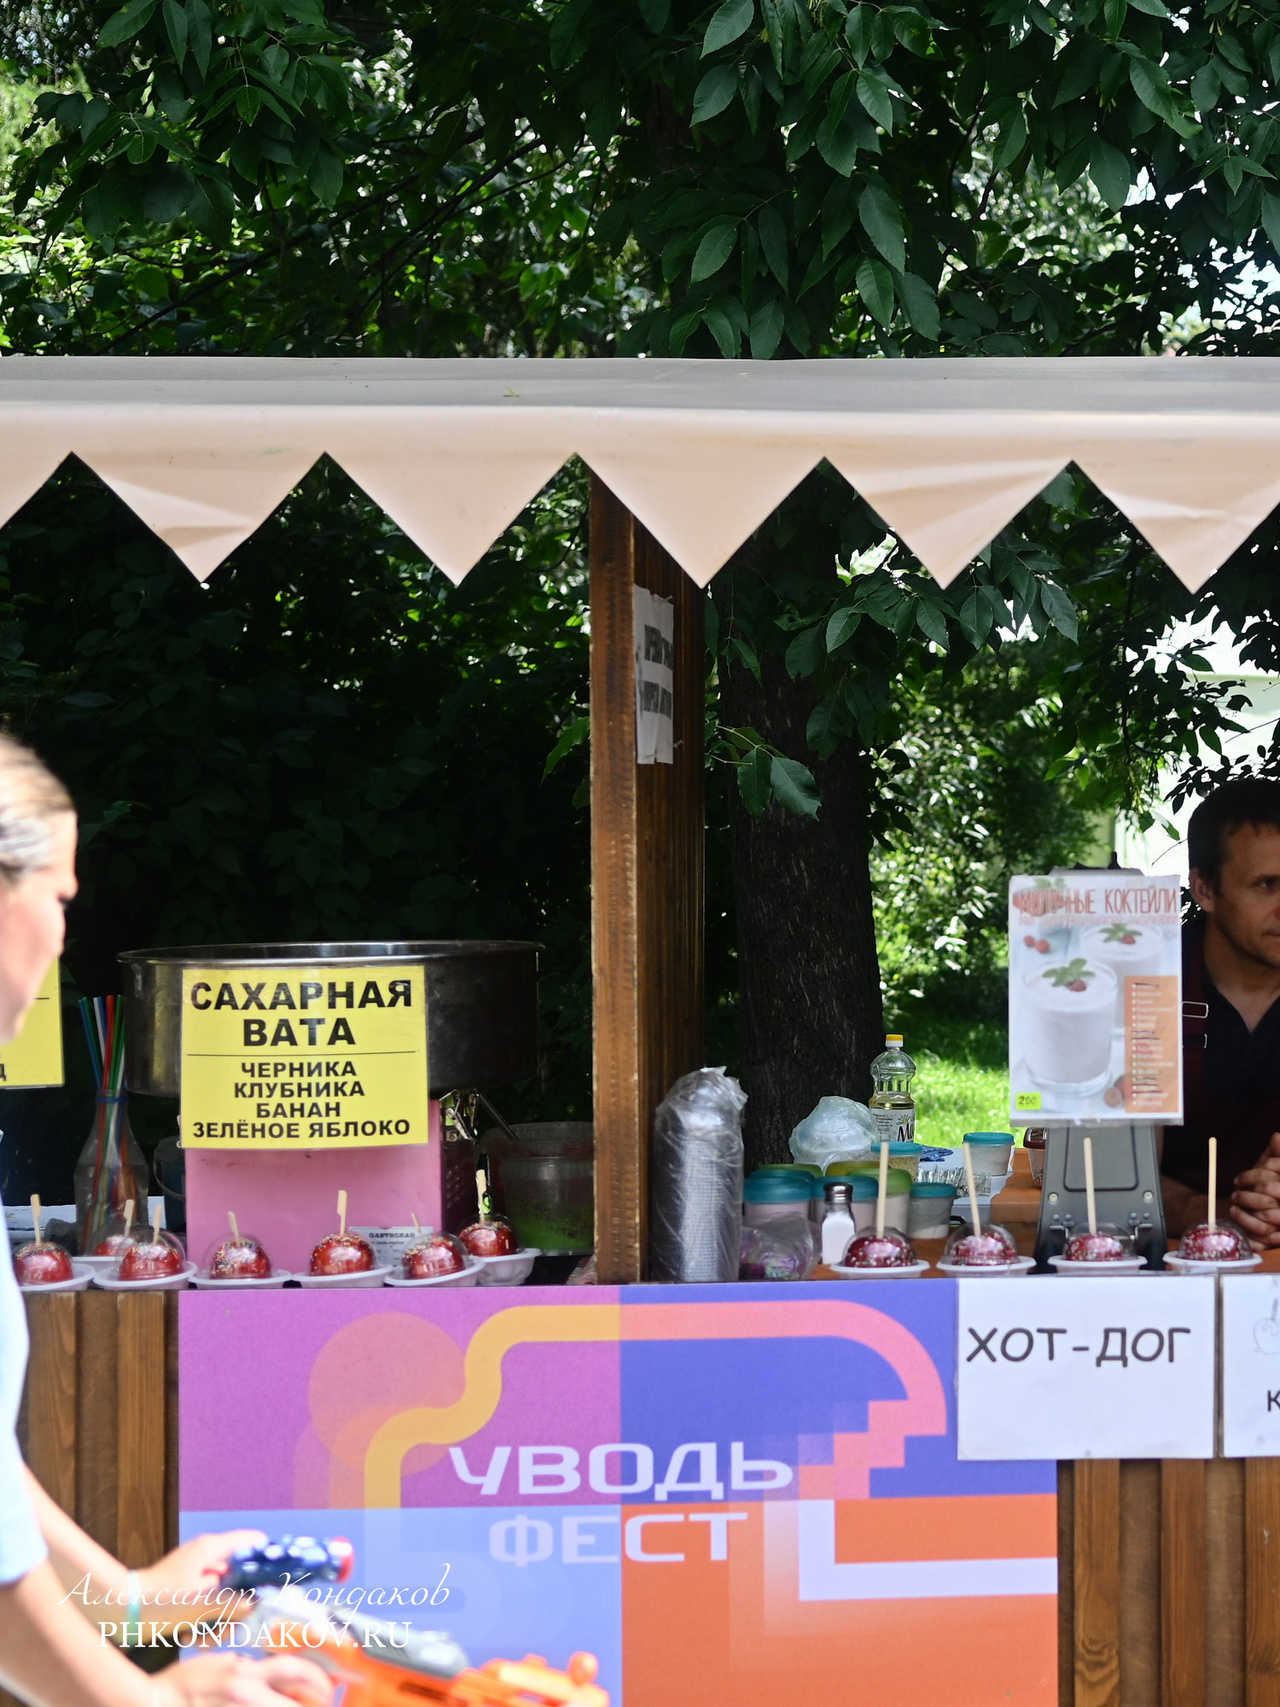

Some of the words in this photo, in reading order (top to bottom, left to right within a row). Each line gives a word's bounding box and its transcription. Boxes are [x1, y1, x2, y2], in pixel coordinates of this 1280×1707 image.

[1019, 889, 1096, 914] МОЛОЧНЫЕ
[1104, 885, 1177, 914] КОКТЕЙЛИ
[190, 979, 412, 1011] САХАРНАЯ
[243, 1017, 356, 1047] ВАТА
[241, 1060, 357, 1078] ЧЕРНИКА
[234, 1081, 365, 1099] КЛУБНИКА
[256, 1101, 341, 1119] БАНАН
[193, 1117, 300, 1139] ЗЕЛЁНОЕ
[308, 1119, 410, 1138] ЯБЛОКО
[965, 1327, 1192, 1368] ХОТ-ДОГ
[449, 1441, 794, 1501] УВОДЬ
[489, 1512, 749, 1567] ФЕСТ
